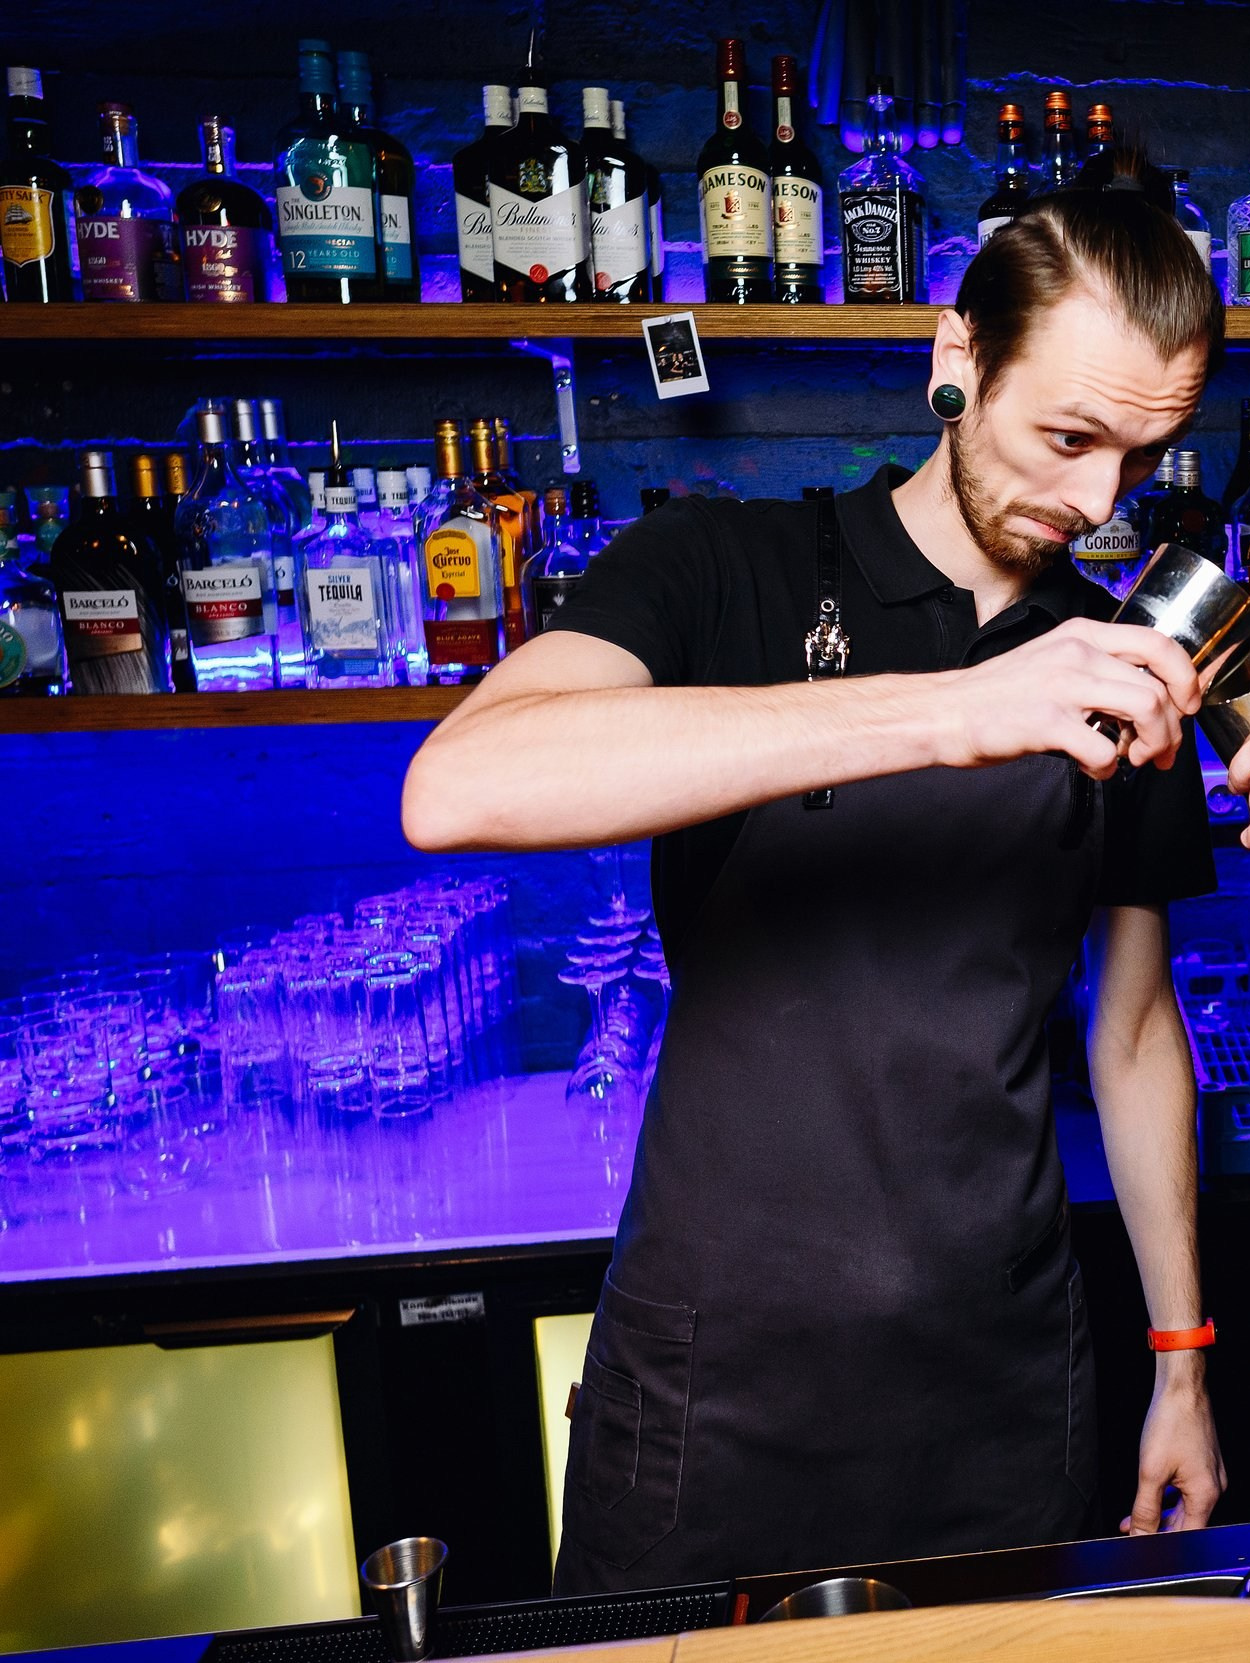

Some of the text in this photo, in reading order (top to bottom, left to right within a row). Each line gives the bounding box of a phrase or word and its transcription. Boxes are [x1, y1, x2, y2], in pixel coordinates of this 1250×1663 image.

[703, 172, 766, 194] JAMESON
[16, 190, 46, 204] SAK
[773, 183, 818, 203] MESON
[283, 201, 361, 221] SINGLETON
[843, 205, 865, 225] JACK
[77, 222, 120, 239] HYDE
[186, 230, 238, 248] HYDE
[308, 250, 361, 258] YEARS OLD
[853, 243, 892, 253] Tennessee
[289, 250, 307, 269] 12
[432, 553, 471, 569] Cuervo
[185, 575, 253, 591] BARCELÓ
[328, 575, 351, 584] SILVER
[318, 585, 363, 602] TEQUILA
[70, 595, 129, 609] BARCELÓ
[195, 602, 248, 613] BLANCO
[79, 621, 125, 630] BLANCO
